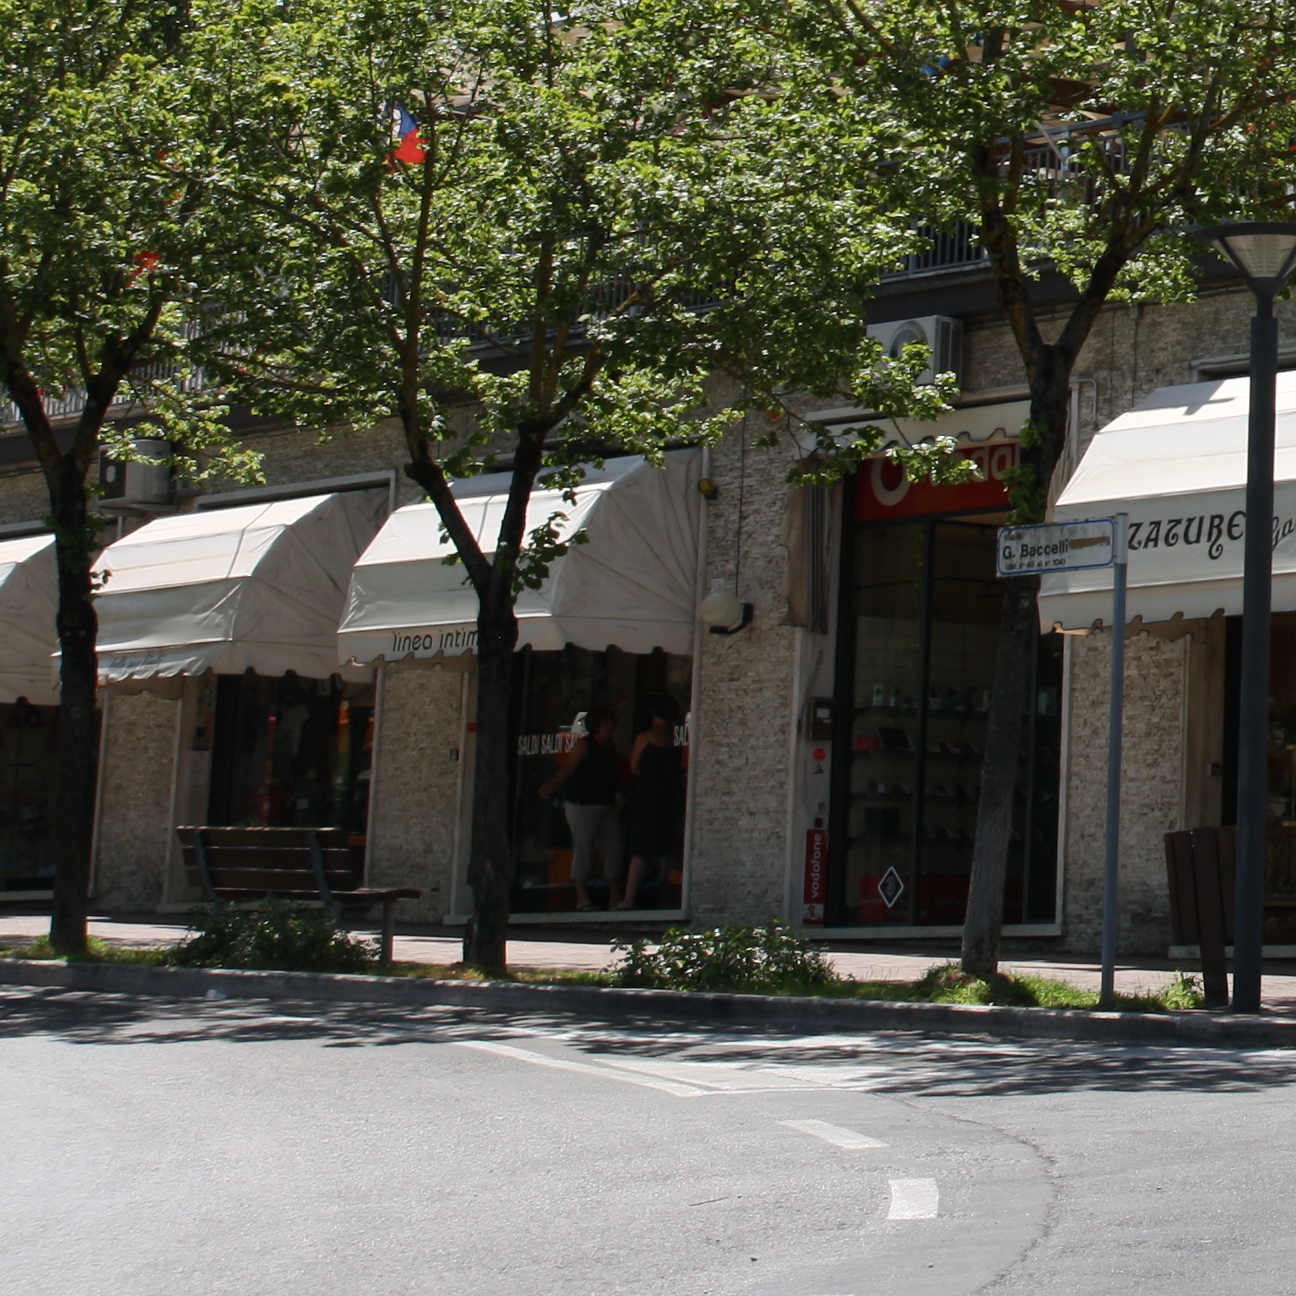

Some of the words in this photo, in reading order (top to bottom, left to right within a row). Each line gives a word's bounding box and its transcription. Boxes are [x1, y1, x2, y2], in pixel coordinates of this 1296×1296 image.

[1128, 509, 1247, 560] ZATURE
[1002, 545, 1016, 560] G.
[1020, 538, 1069, 558] Baccelli
[392, 630, 433, 653] linea
[439, 628, 479, 648] intim
[518, 734, 540, 756] SALDI
[541, 733, 563, 755] SALDI
[673, 724, 689, 747] SAL
[810, 833, 823, 899] vodafone
